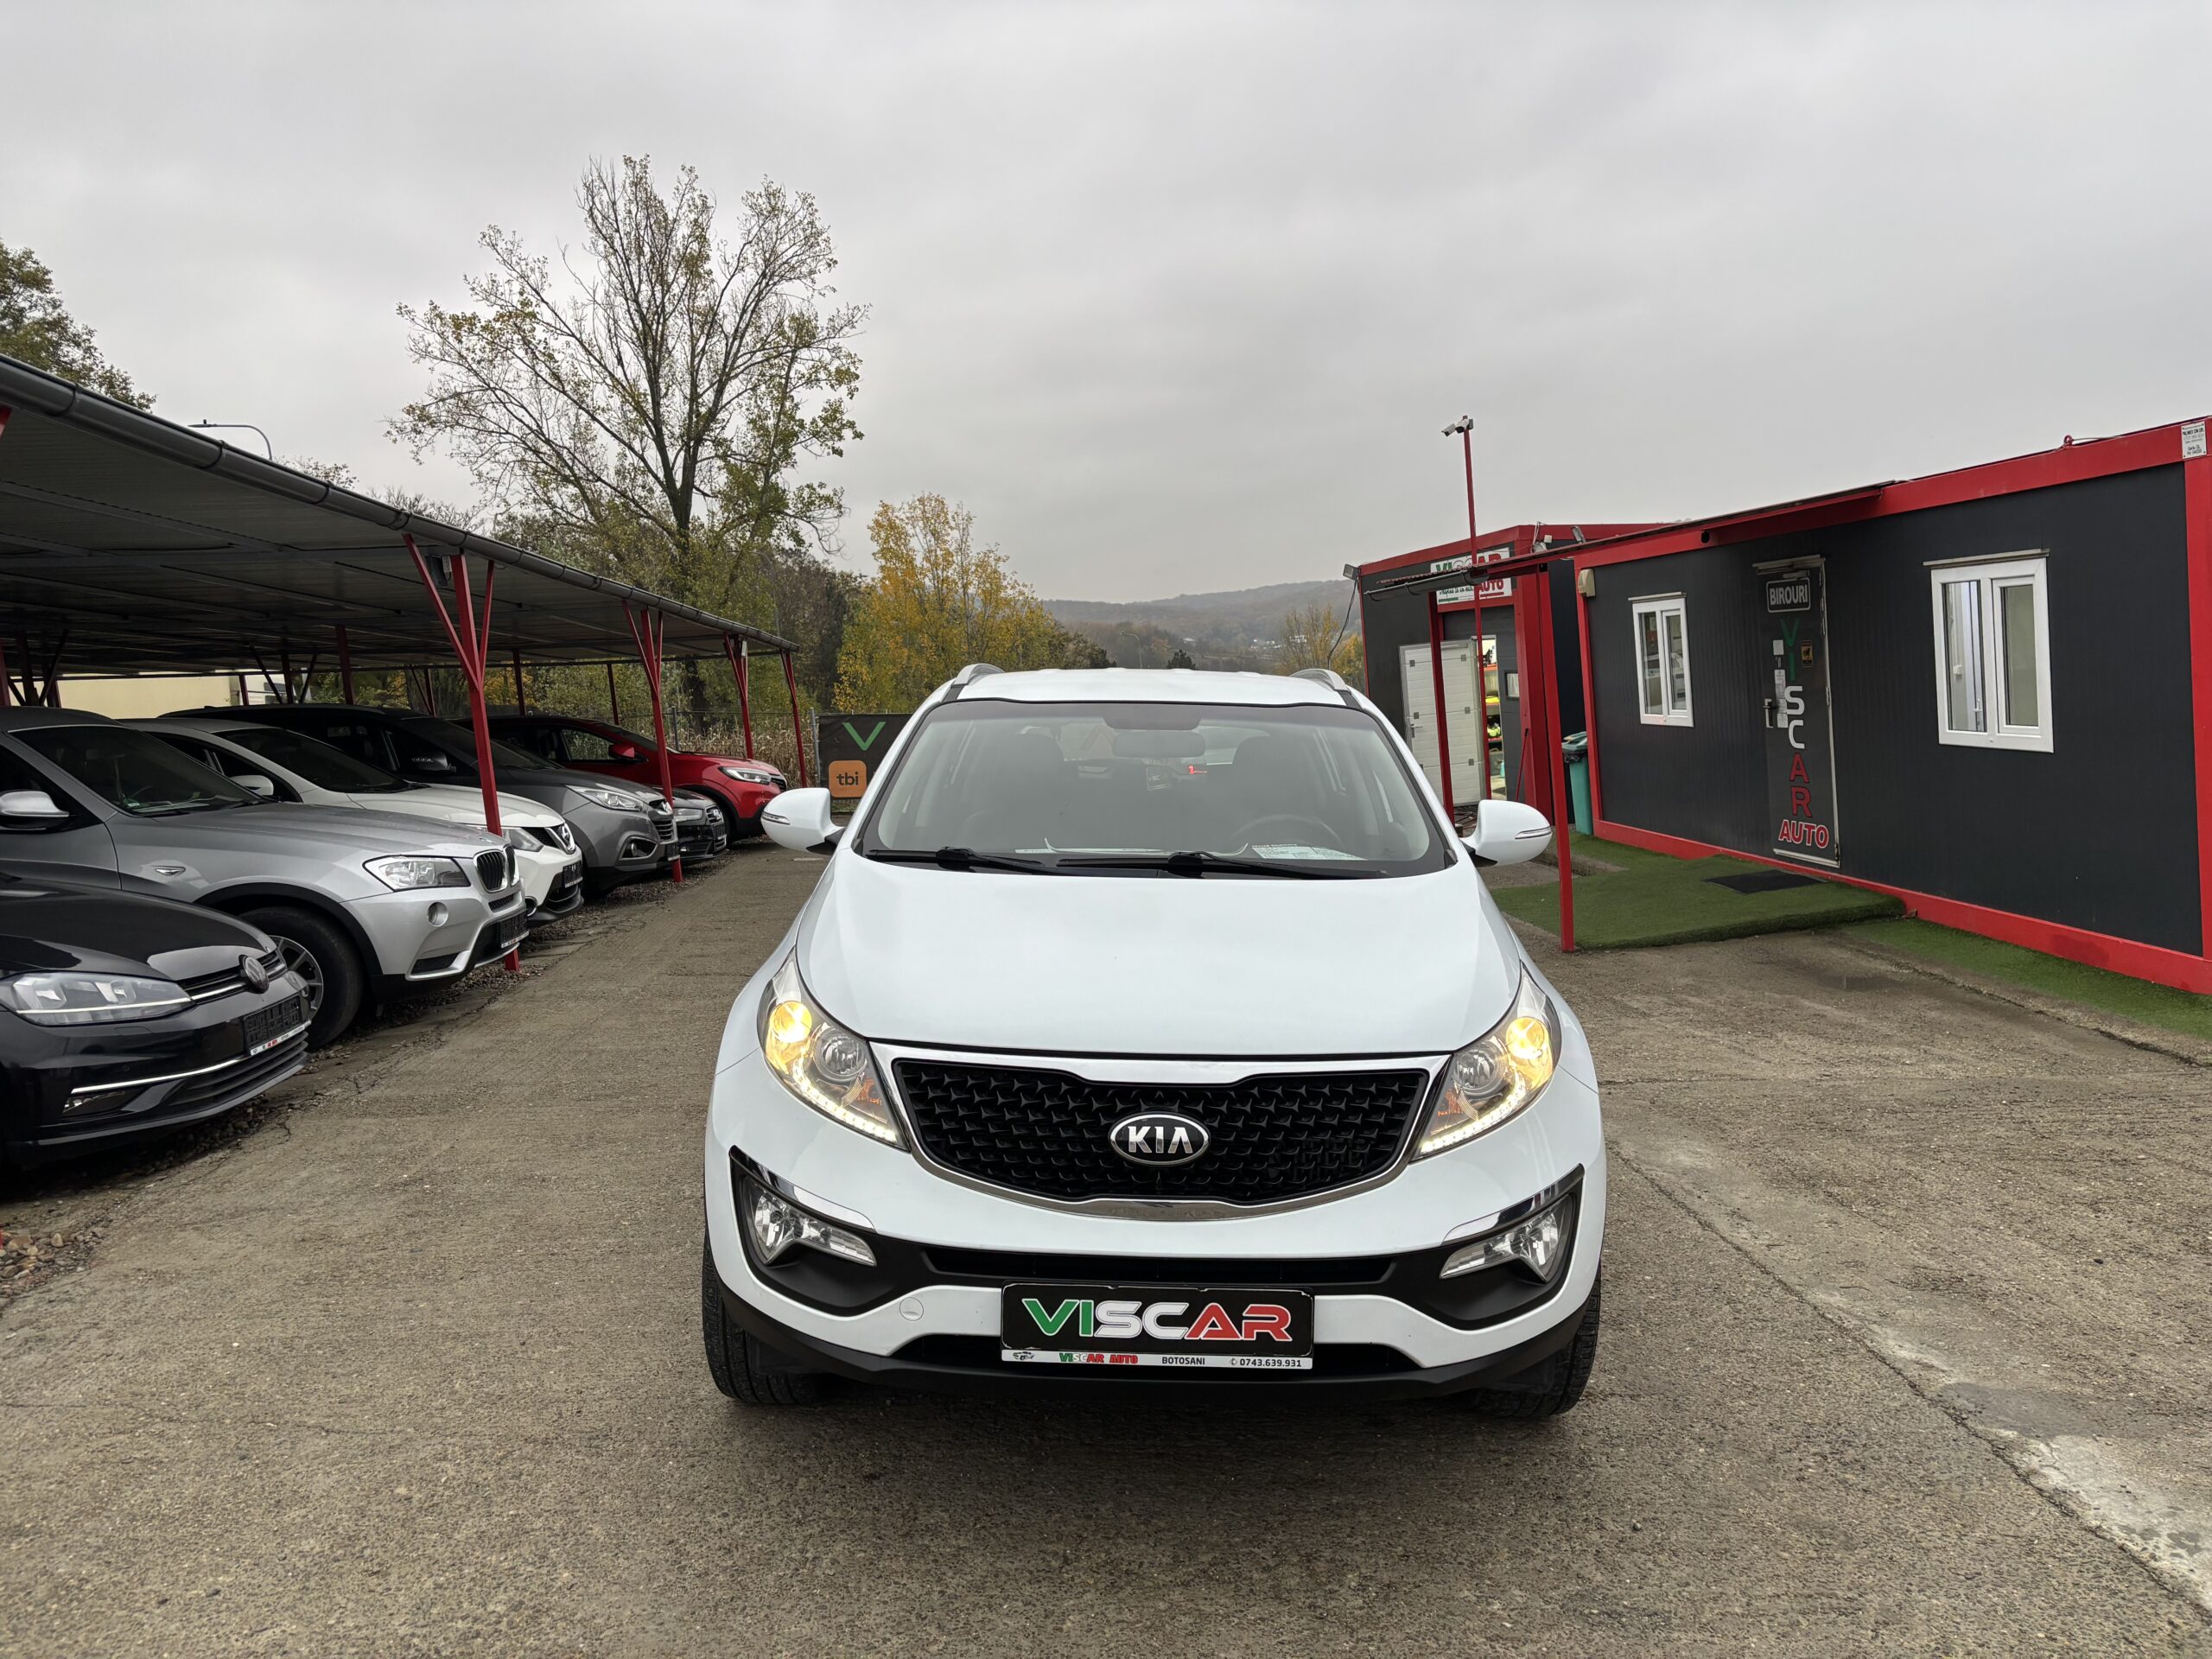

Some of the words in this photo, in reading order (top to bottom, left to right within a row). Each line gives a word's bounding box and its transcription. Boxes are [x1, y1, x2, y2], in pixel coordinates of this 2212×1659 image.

[1769, 584, 1808, 605] BIROURI
[836, 772, 858, 785] tbi
[1778, 819, 1829, 849] AUTO
[1128, 1126, 1192, 1154] KIA
[1021, 1298, 1293, 1342] VISCAR
[1058, 1352, 1104, 1363] VISCAR
[1109, 1354, 1138, 1364] AUTO
[1162, 1357, 1205, 1365] BOTOSANI
[1239, 1358, 1301, 1368] 0743.639.931
